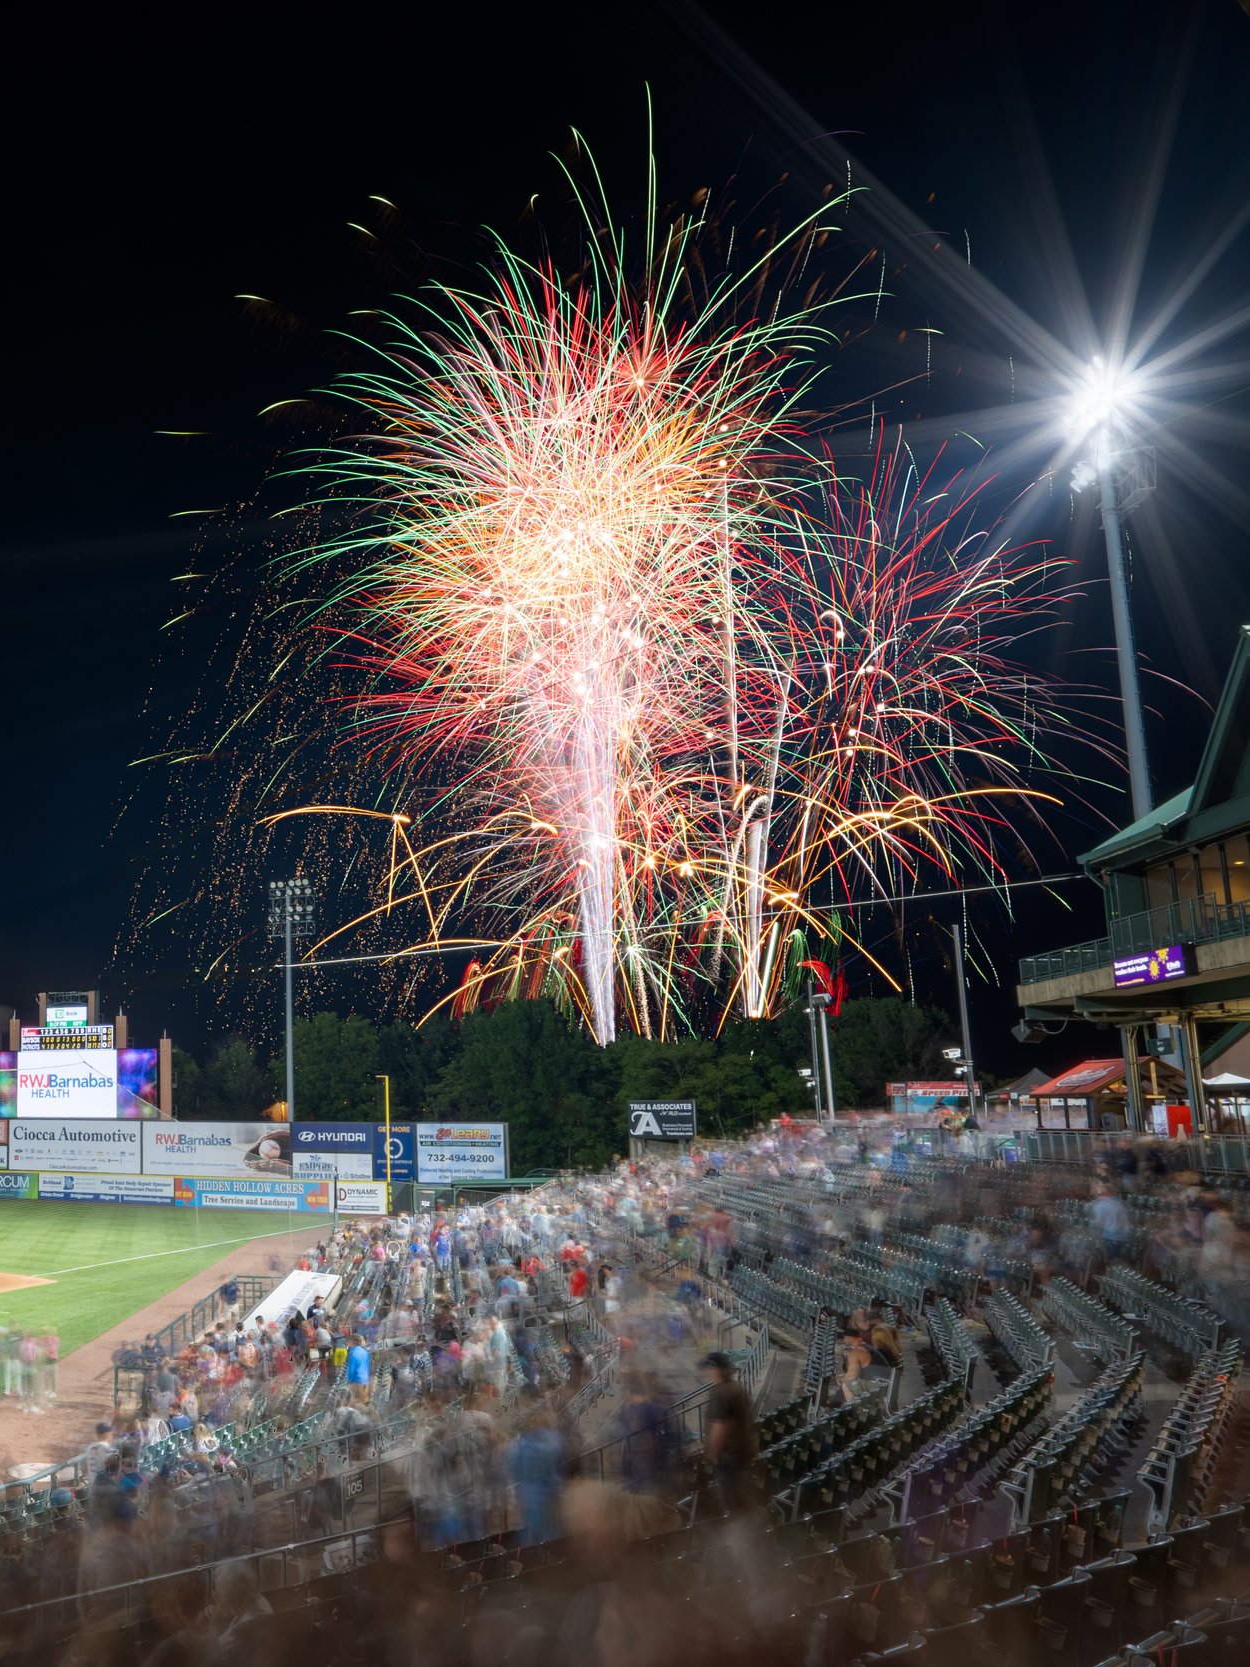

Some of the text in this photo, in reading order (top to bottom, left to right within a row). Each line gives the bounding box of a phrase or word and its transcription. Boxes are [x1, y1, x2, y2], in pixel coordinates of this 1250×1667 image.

[20, 1073, 113, 1088] RWJBarnabas
[31, 1089, 70, 1098] HEALTH
[13, 1126, 137, 1143] Ciocca Automotive
[318, 1132, 366, 1142] HYUNDAI
[156, 1133, 232, 1147] RWJBarnabas
[165, 1145, 196, 1154] HEALTH
[427, 1154, 495, 1163] 732-494-9200
[299, 1162, 333, 1171] EMPIRE
[195, 1180, 305, 1195] HIDDEN HOLLOW ACRES
[347, 1188, 378, 1196] DYNAMIC
[204, 1194, 296, 1208] Tree Service and Landscape
[316, 1196, 328, 1204] TREE
[347, 1480, 363, 1496] 105
